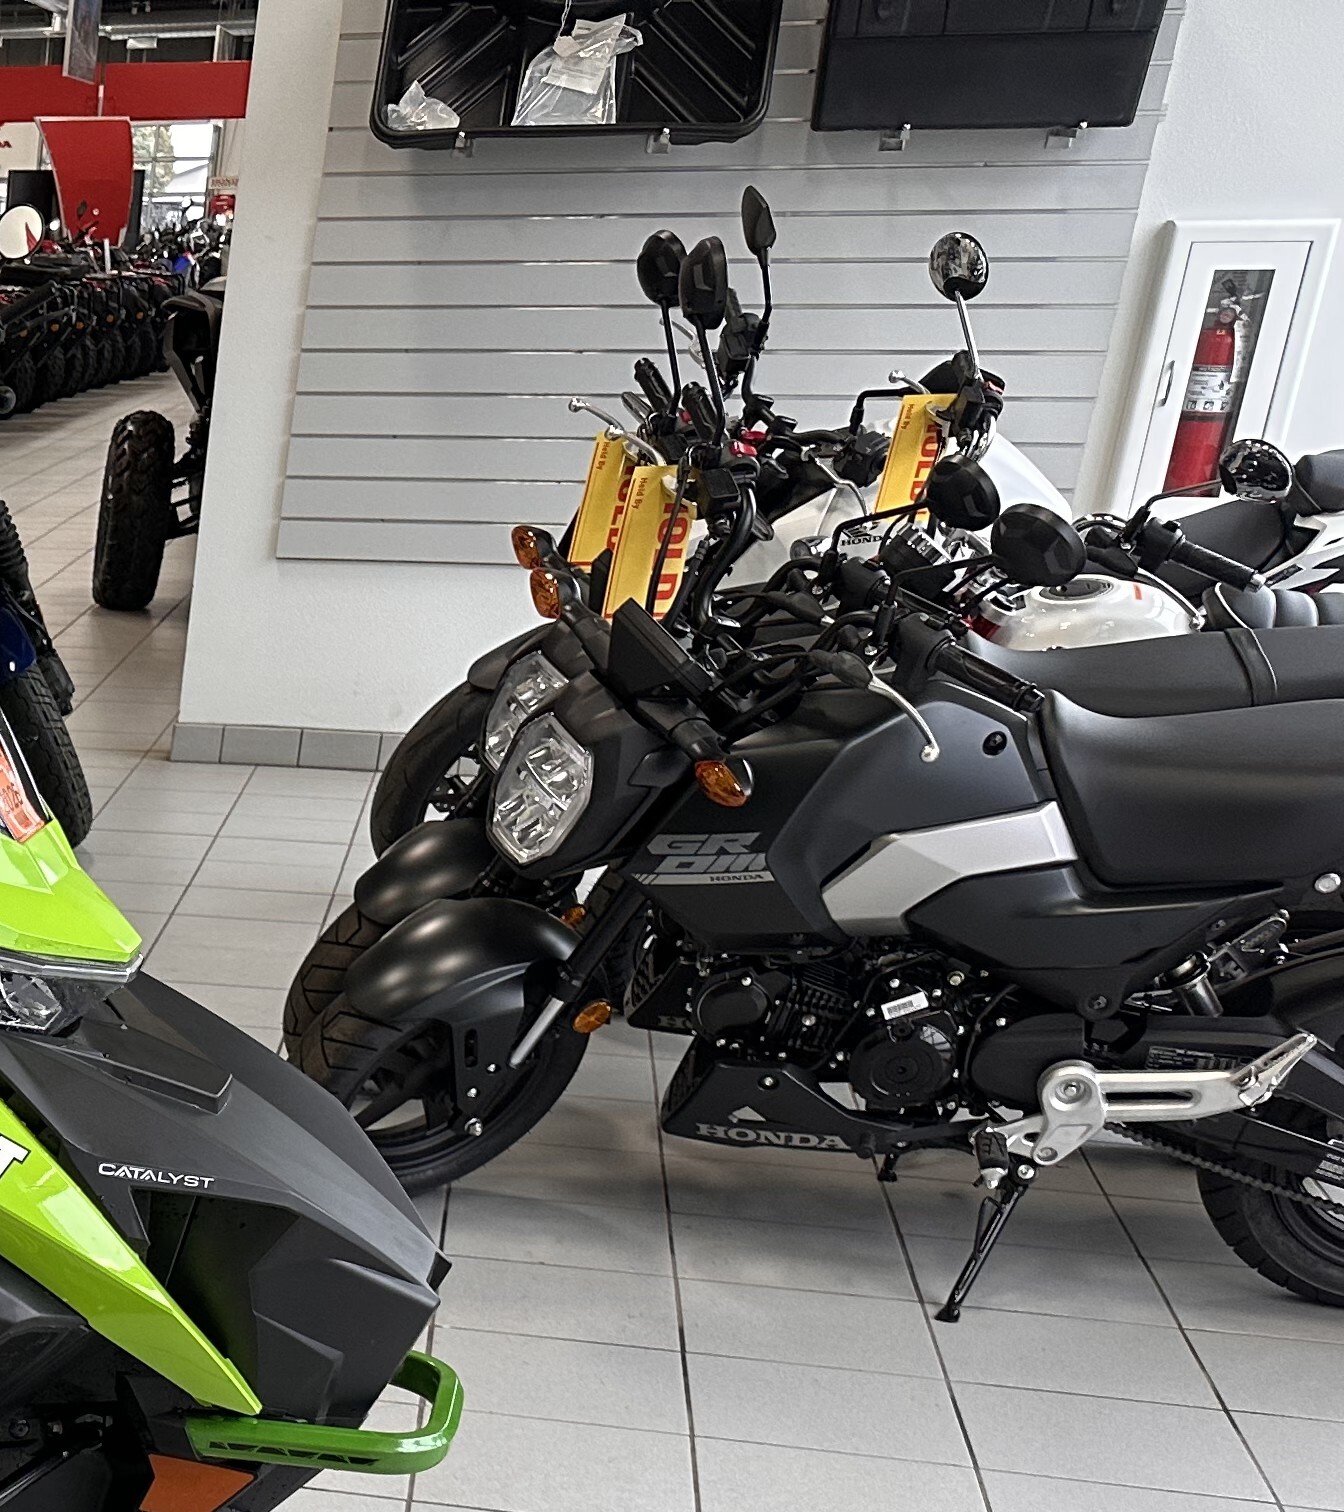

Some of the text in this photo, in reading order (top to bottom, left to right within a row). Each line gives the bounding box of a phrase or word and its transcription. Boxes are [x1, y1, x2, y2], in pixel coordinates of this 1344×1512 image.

[841, 535, 882, 547] HOND
[646, 832, 761, 855] GR
[710, 874, 765, 882] HONDA
[696, 1123, 852, 1150] HONDA
[98, 1162, 216, 1189] CATALYST
